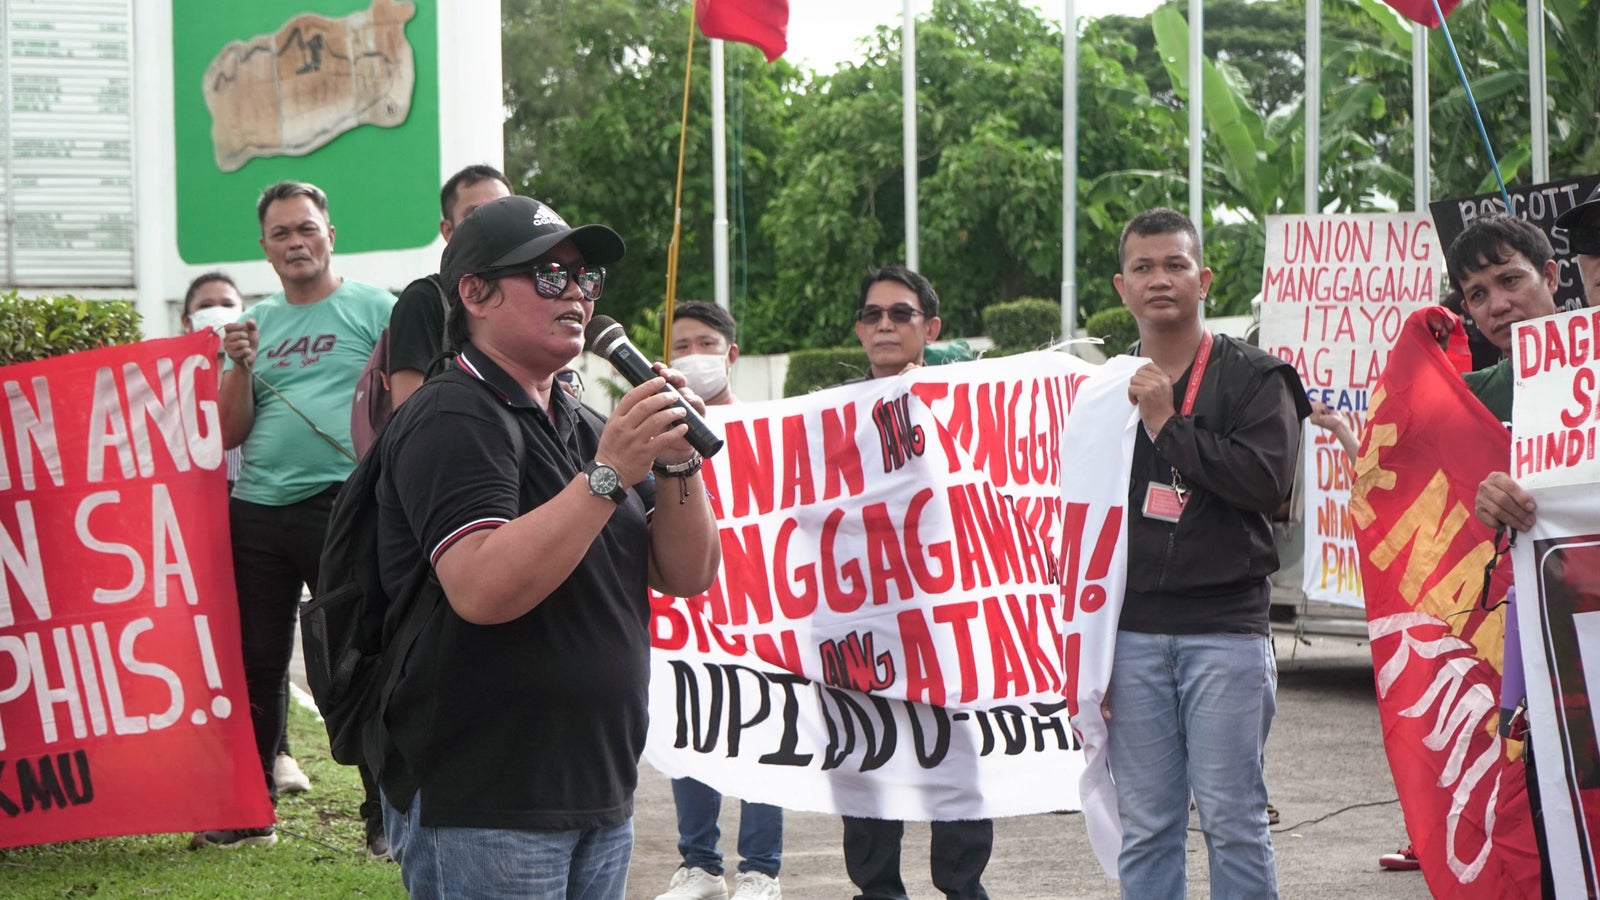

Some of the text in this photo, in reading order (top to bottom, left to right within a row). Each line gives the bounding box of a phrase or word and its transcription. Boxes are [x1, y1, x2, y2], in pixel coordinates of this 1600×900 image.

[1284, 220, 1431, 264] UNION NG
[1264, 265, 1433, 304] MANGGAGAWA
[267, 334, 336, 359] JAG
[1302, 304, 1401, 344] ITAYO
[1349, 349, 1394, 390] LA
[87, 354, 223, 482] ANG
[1560, 367, 1600, 428] S
[872, 394, 925, 473] ANG
[1516, 427, 1596, 479] HINDI
[75, 484, 198, 606] SA
[819, 630, 896, 693] ANG
